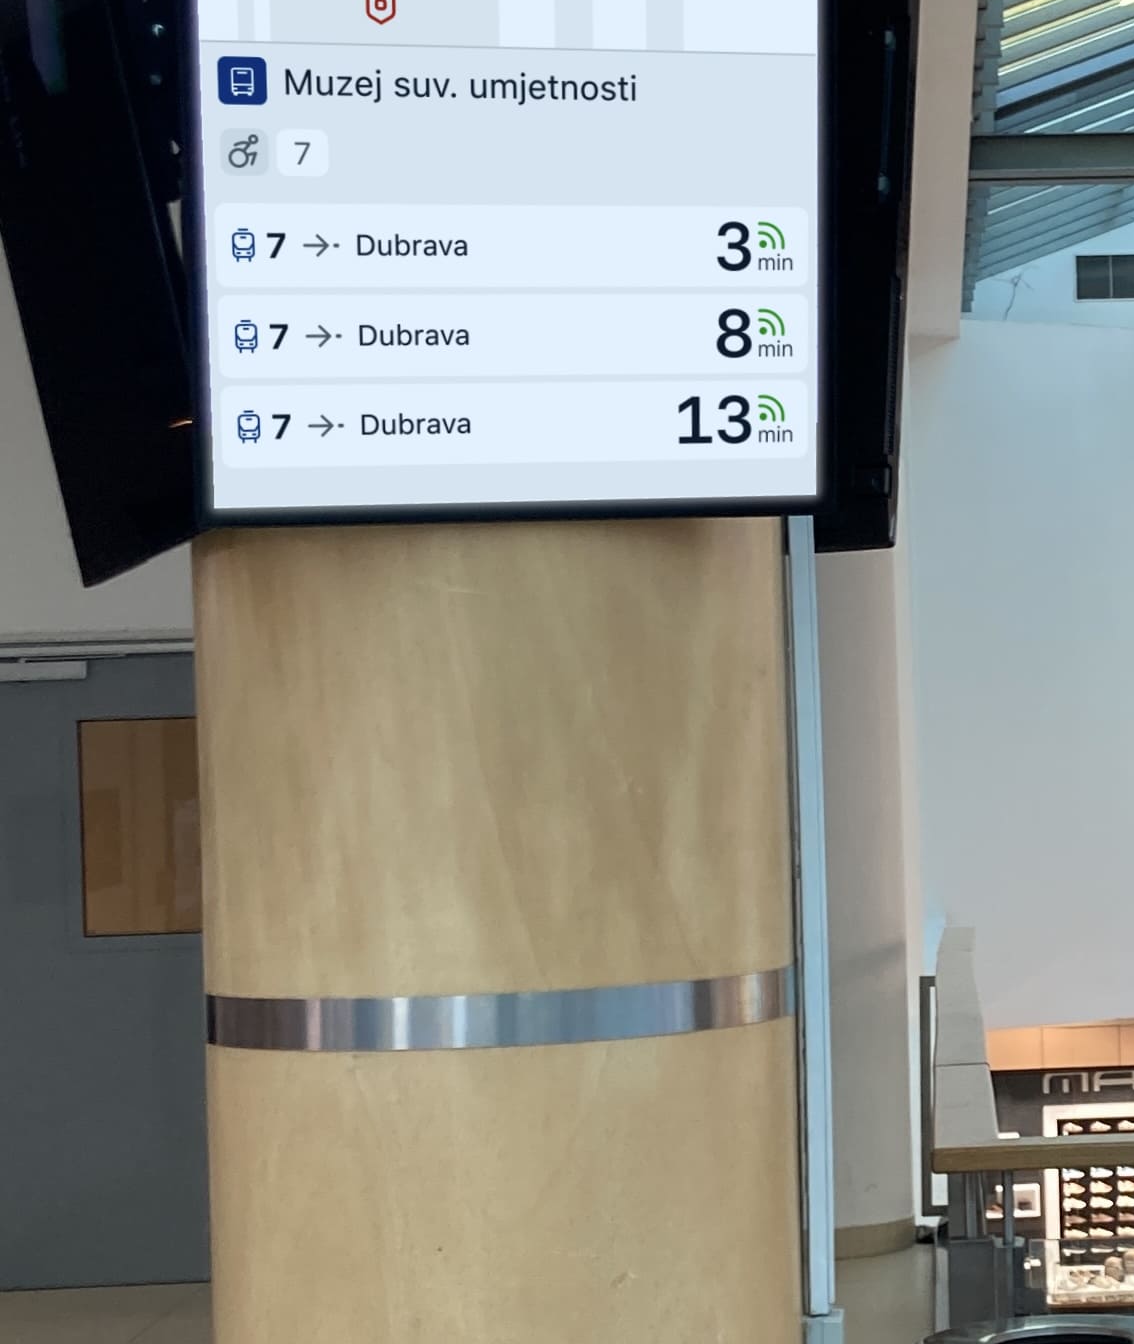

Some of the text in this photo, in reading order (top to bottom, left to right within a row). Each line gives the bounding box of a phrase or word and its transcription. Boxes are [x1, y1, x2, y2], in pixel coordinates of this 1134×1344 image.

[284, 68, 637, 106] Muzej suv. umjetnosti
[294, 142, 311, 165] 7
[266, 221, 794, 272] 7 Dubrava 3 min
[269, 308, 793, 359] 7 Dubrava 8 min
[271, 395, 793, 445] 7 Dubrava 13 min
